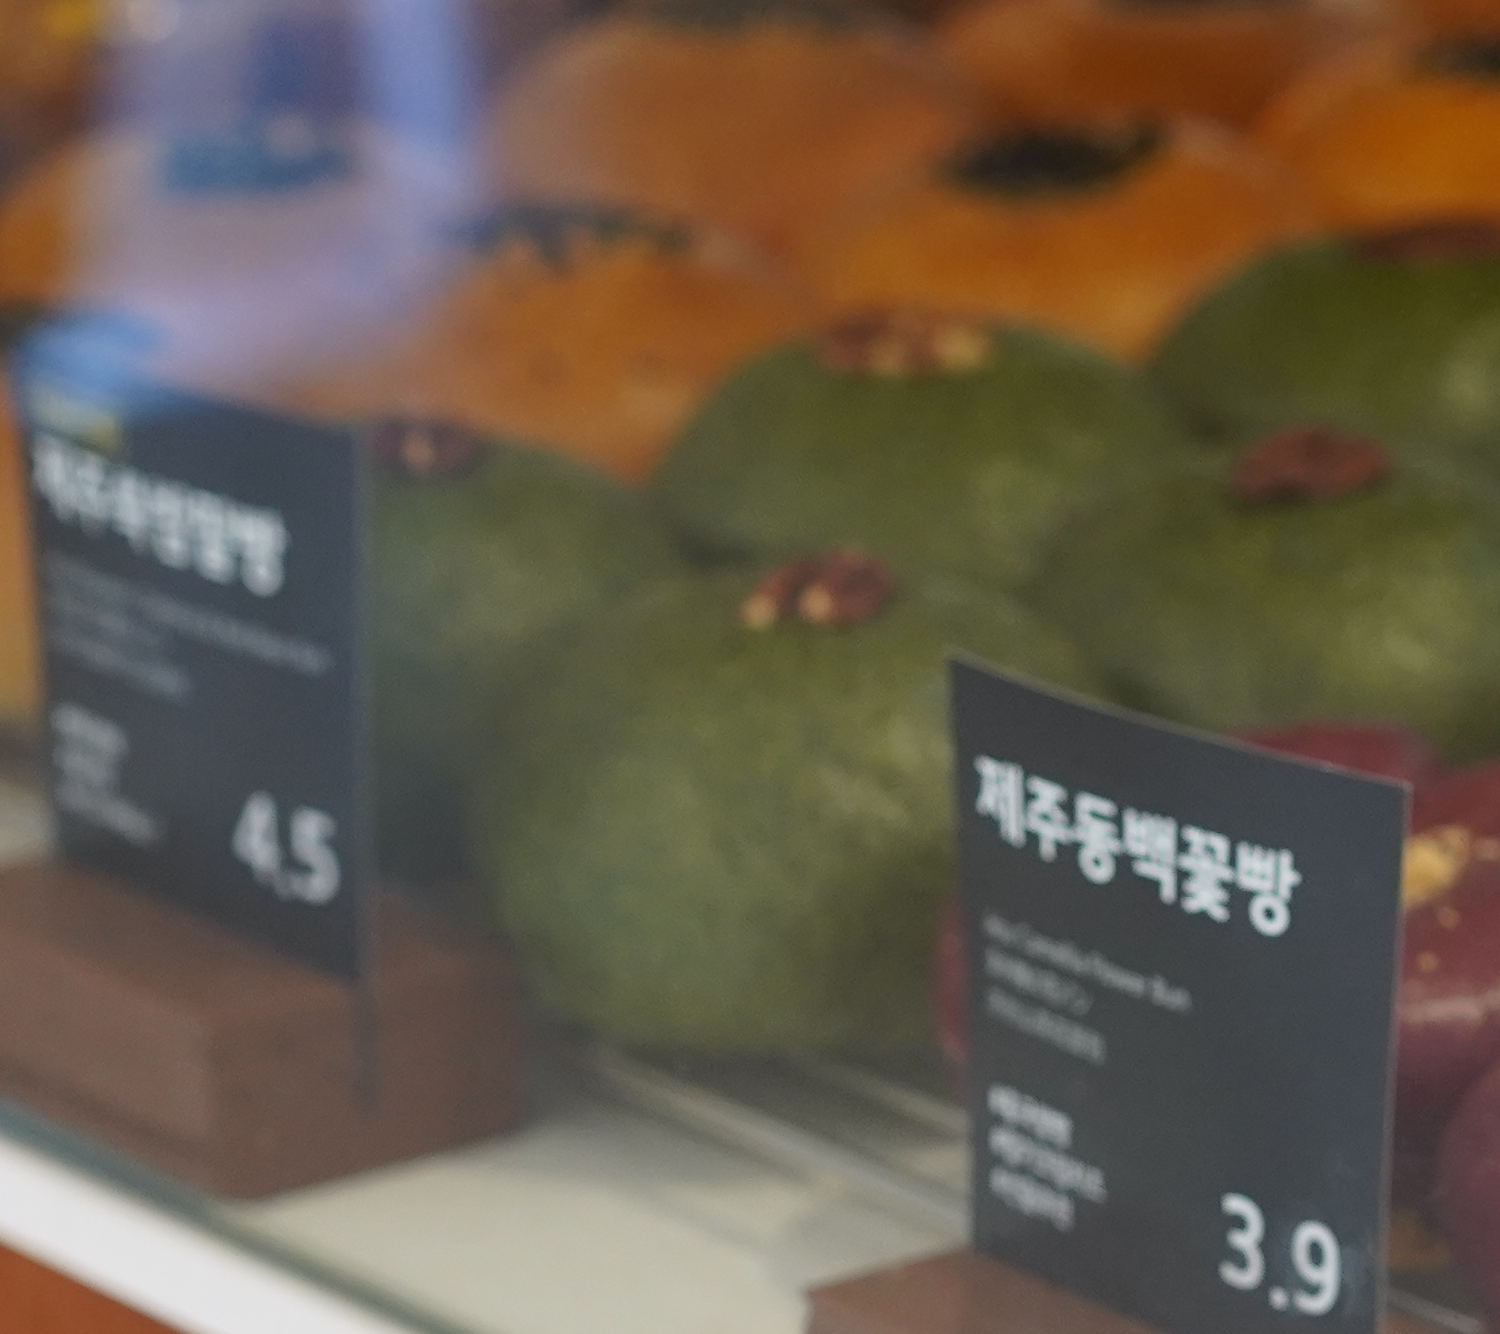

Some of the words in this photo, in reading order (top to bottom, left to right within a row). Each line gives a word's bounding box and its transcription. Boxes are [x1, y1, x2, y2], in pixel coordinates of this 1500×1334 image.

[232, 791, 342, 905] 4.5
[974, 755, 1301, 938] 제주동백꽃빵
[1219, 1192, 1342, 1316] 3.9
